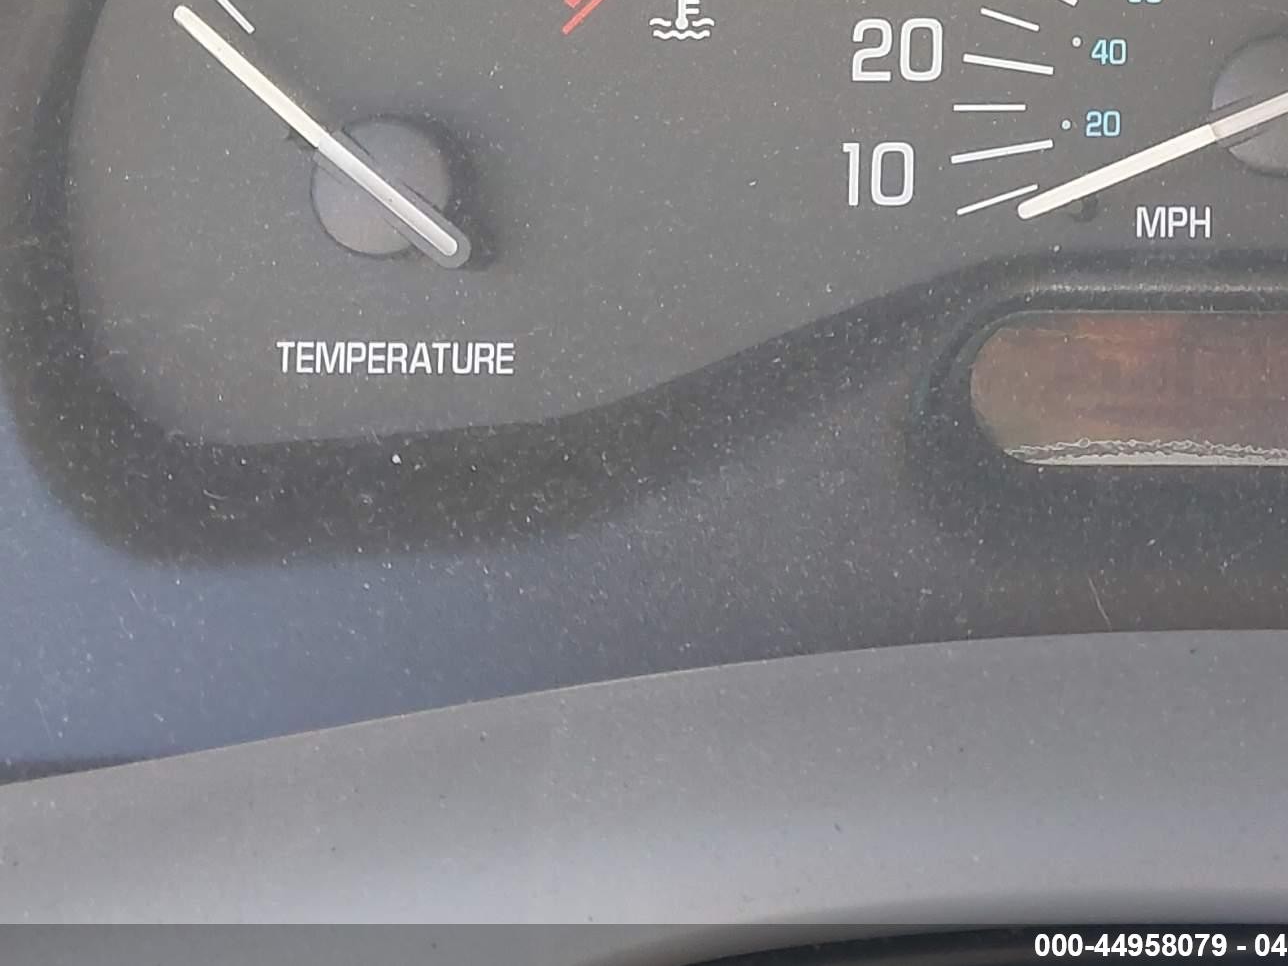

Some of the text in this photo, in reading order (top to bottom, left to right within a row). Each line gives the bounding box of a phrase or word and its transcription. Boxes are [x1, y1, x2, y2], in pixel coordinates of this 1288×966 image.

[852, 17, 943, 82] 20
[1091, 39, 1127, 65] 40
[1085, 110, 1121, 137] 20
[842, 142, 914, 206] 10
[1136, 206, 1211, 238] MPH
[276, 341, 515, 375] TEMPERATURE
